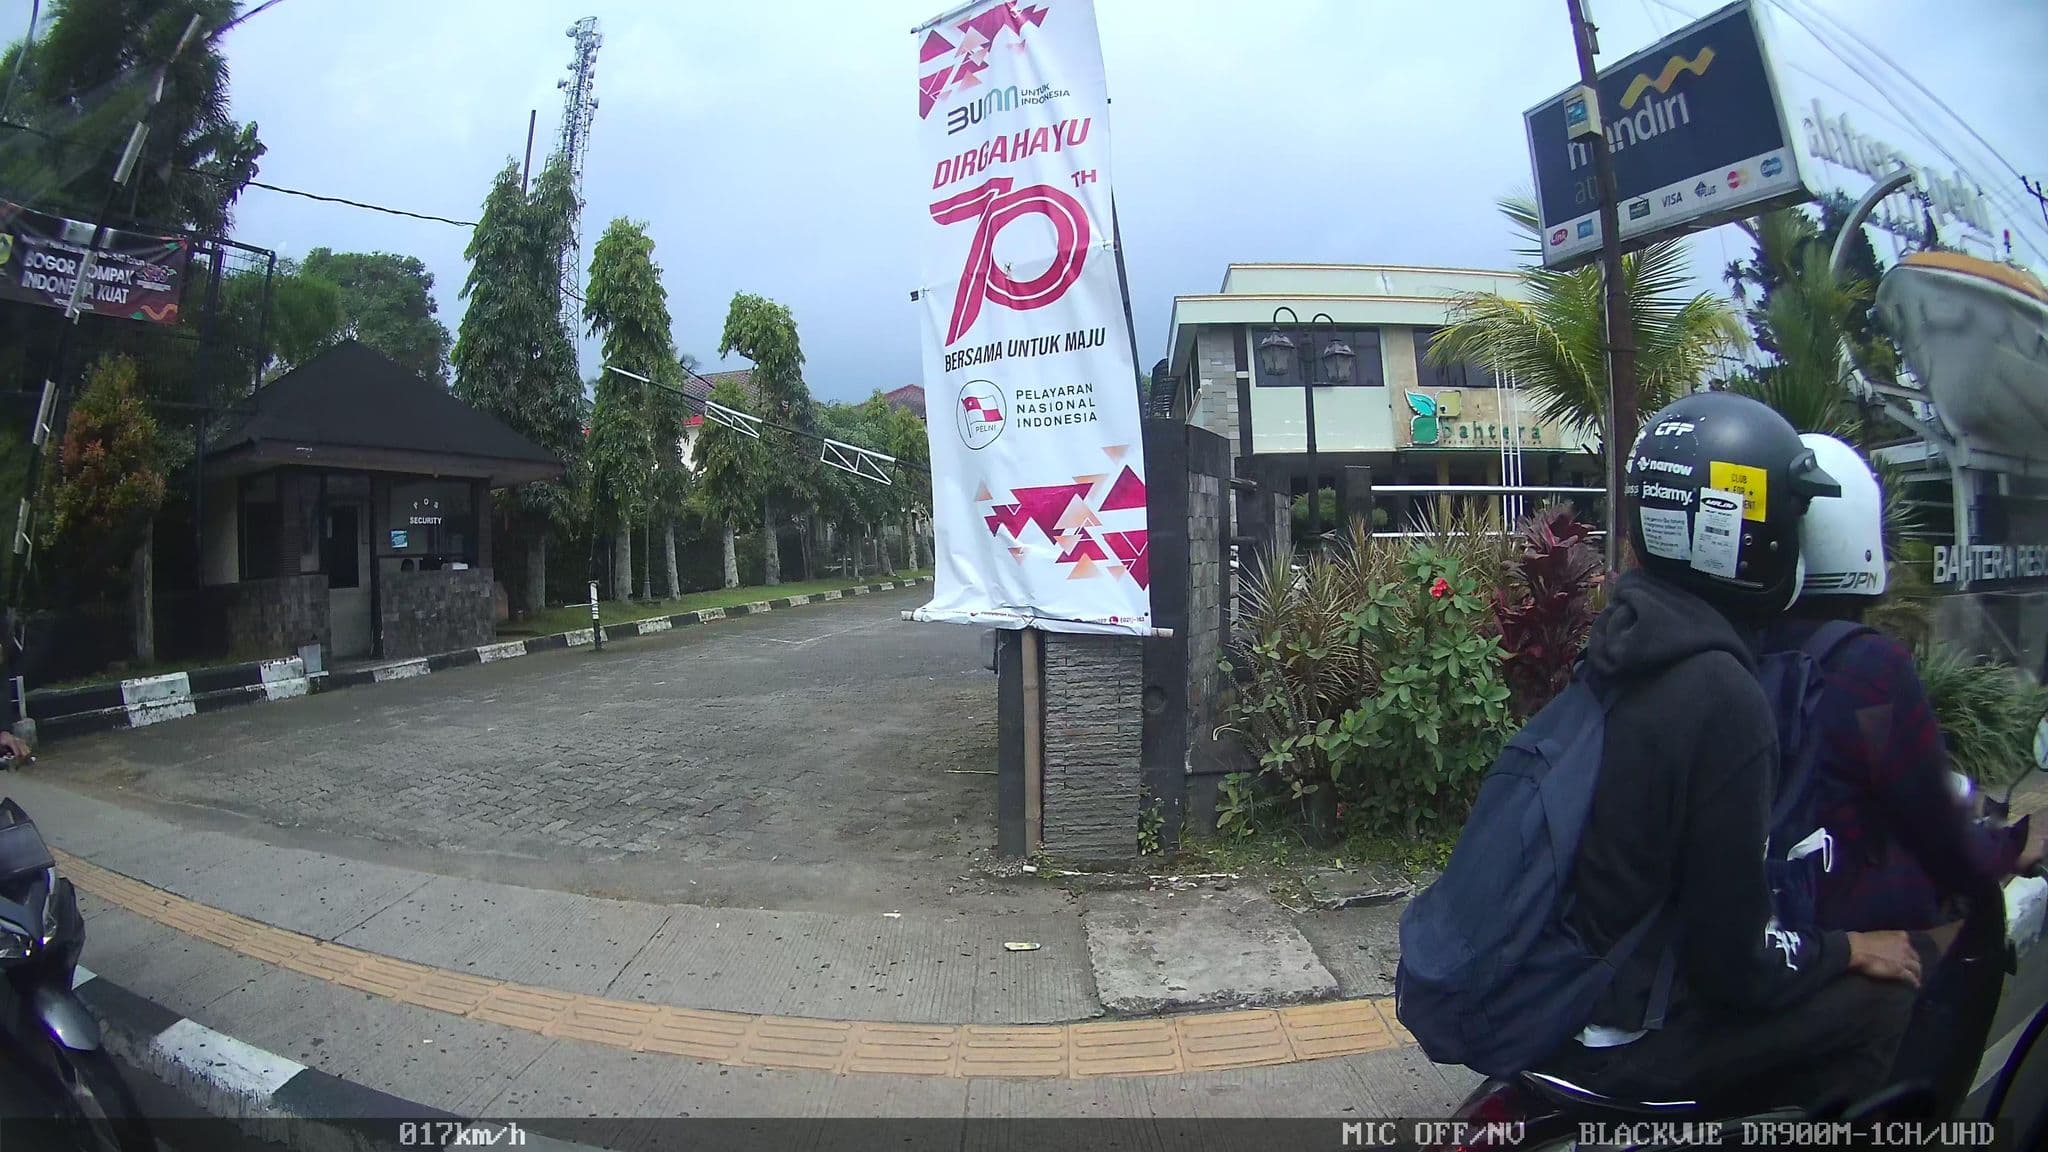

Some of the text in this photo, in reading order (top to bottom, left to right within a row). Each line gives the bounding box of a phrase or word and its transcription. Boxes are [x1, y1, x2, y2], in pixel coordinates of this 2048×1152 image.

[1021, 84, 1050, 98] UNTUK
[1021, 89, 1070, 105] INDONESIA
[933, 118, 1091, 189] DIRGAHAYU
[1662, 192, 1683, 208] VISA
[929, 169, 1096, 348] 70 TH
[24, 250, 76, 276] BOGOR
[80, 262, 135, 286] OMPAK
[21, 270, 95, 299] INDONEIA
[97, 284, 130, 304] KUAT
[945, 327, 1106, 373] BERSAMA UNTUK MAJU
[1016, 383, 1094, 400] PELAYARAN
[1016, 397, 1096, 415] NASIONAL
[975, 424, 998, 433] PELNI
[1017, 411, 1098, 429] INDONESIA
[1441, 421, 1542, 439] bahtera
[1650, 460, 1693, 476] narrow
[1731, 473, 1748, 484] CLUB
[409, 516, 442, 525] SECURITY
[1933, 544, 2015, 583] BAHTERA
[1840, 572, 1878, 589] JPN
